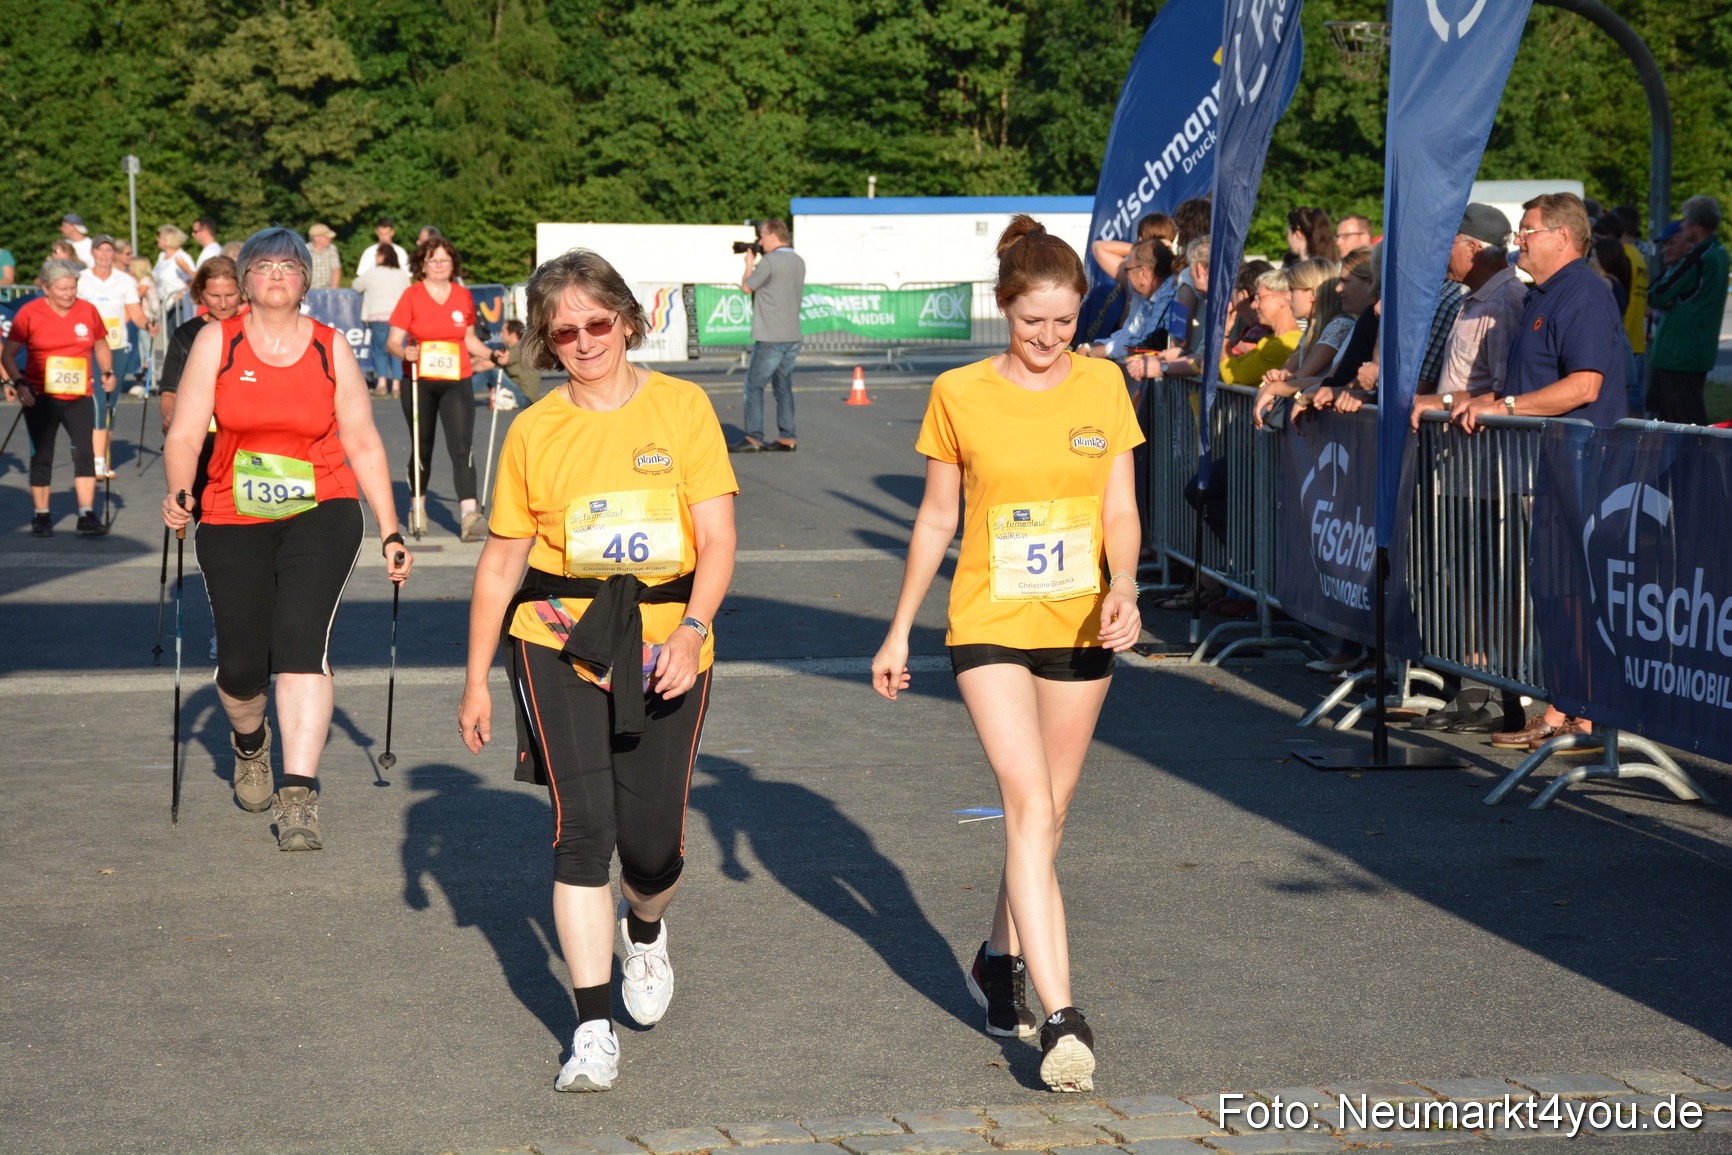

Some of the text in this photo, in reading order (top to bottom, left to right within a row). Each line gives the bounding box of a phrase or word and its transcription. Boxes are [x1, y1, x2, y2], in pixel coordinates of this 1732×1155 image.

[1181, 130, 1217, 174] Druck
[707, 294, 753, 324] AOK
[919, 292, 967, 320] AOK
[429, 356, 453, 369] 263
[55, 372, 79, 384] 265
[573, 522, 605, 533] walken
[583, 509, 624, 521] firmenlauf
[1006, 518, 1046, 528] firmenlauf
[602, 532, 650, 563] 46
[995, 531, 1028, 540] walken
[1026, 540, 1064, 575] 51
[1607, 558, 1732, 658] Fische
[1625, 656, 1732, 710] AUTOMOBIL
